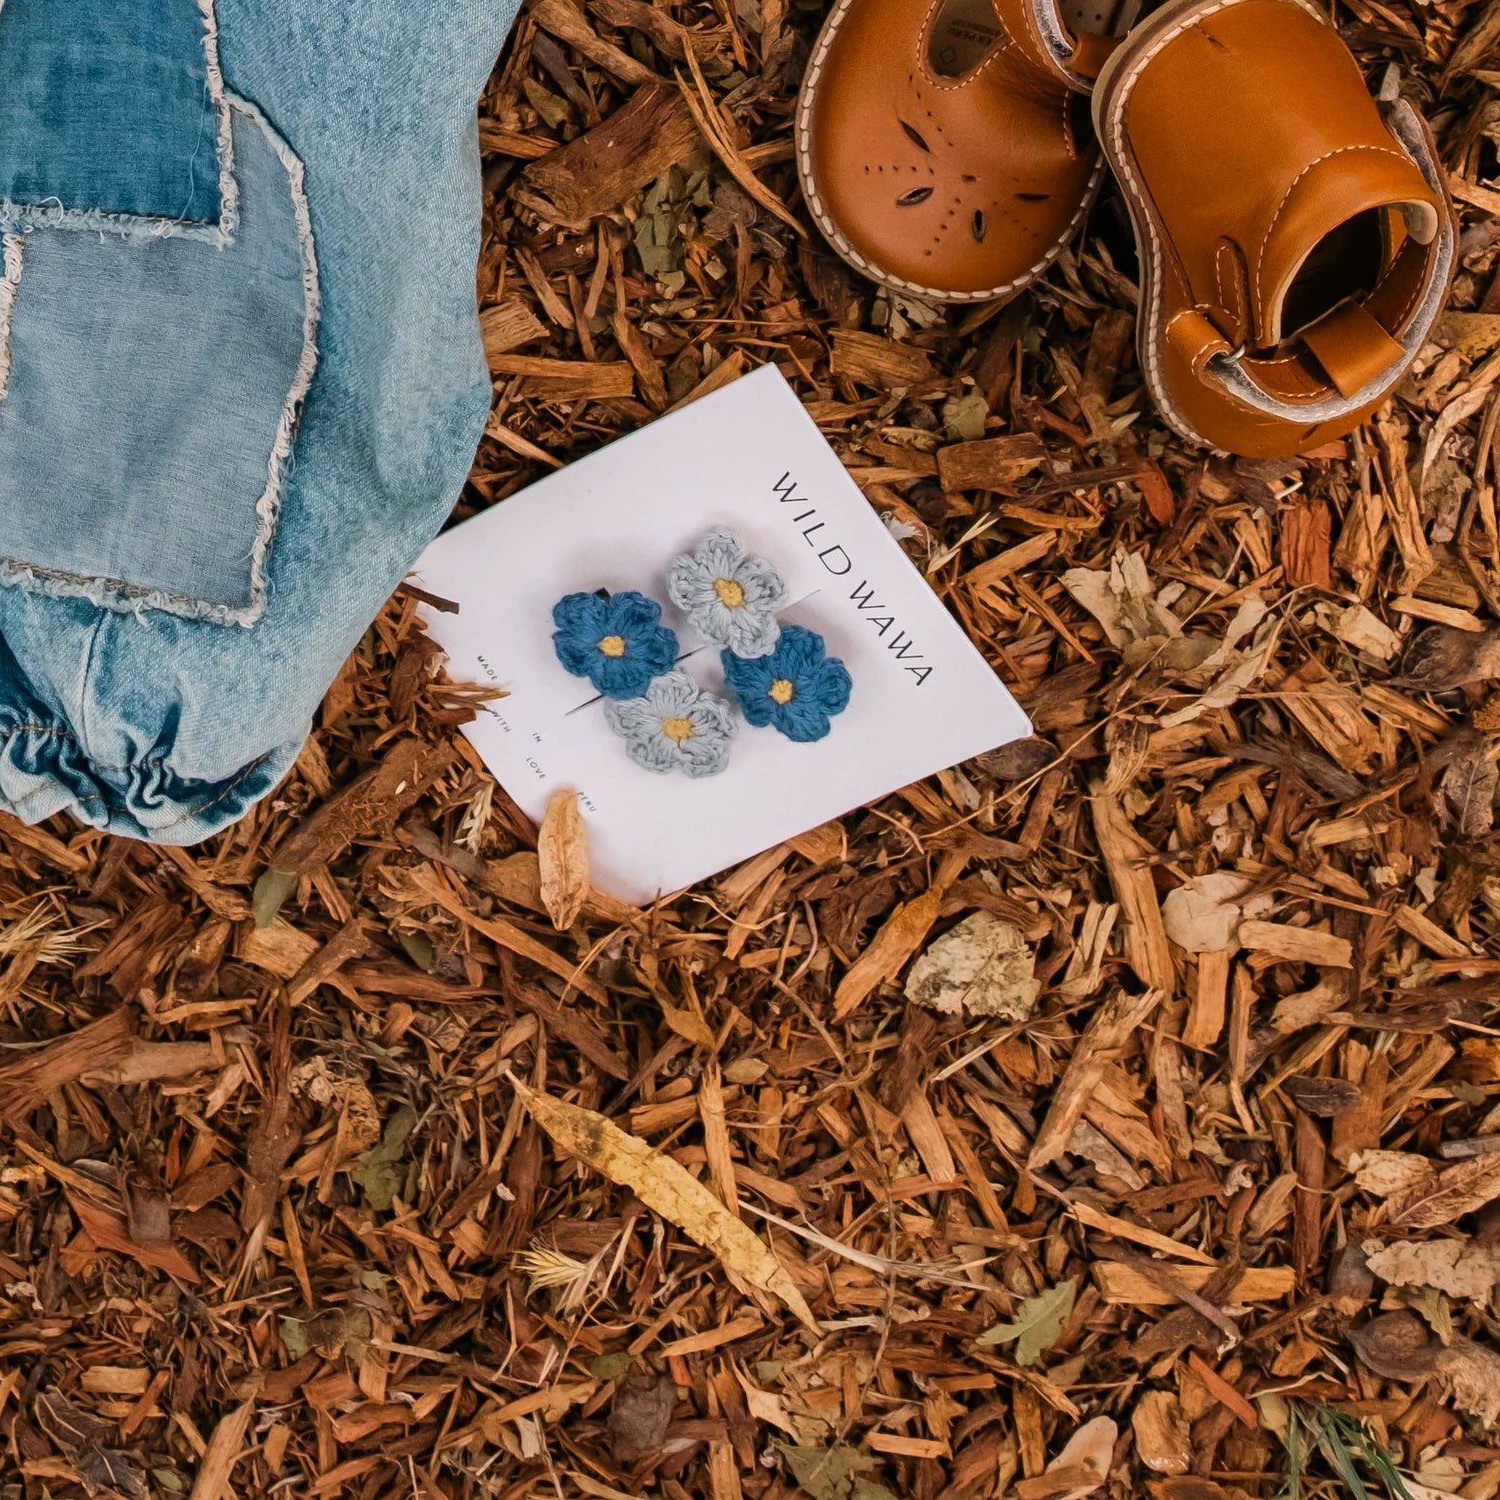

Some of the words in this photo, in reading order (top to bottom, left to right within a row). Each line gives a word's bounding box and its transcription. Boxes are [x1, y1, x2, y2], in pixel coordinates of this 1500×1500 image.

[772, 471, 852, 576] WILD
[849, 579, 934, 687] WAWA
[476, 655, 499, 681] MADE
[532, 732, 542, 743] IN
[577, 791, 597, 812] PERU
[490, 709, 511, 733] WITH
[525, 757, 547, 779] LOVE
